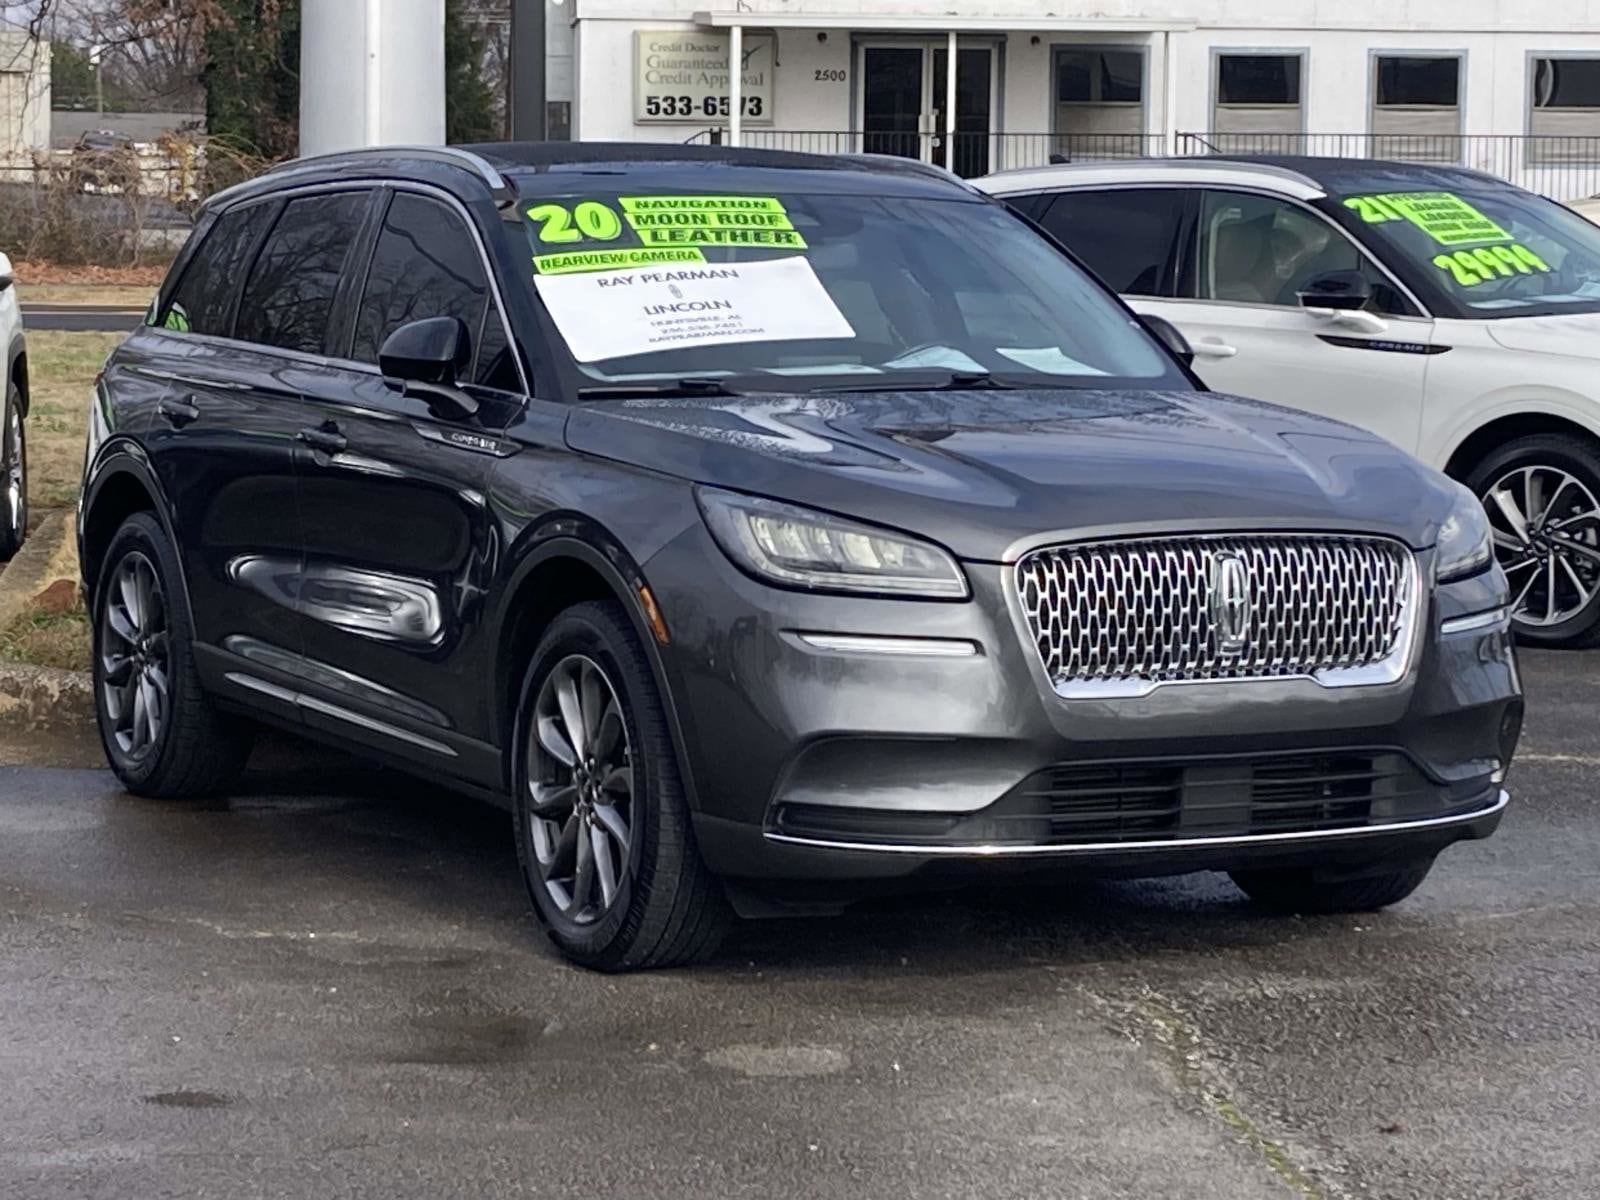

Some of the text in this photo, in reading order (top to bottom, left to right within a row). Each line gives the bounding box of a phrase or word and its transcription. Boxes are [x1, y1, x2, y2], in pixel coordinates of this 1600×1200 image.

[650, 42, 720, 52] Credit Doctor
[646, 55, 730, 70] Guaranteed
[645, 71, 764, 88] Credit Appval
[814, 69, 847, 82] 2500
[634, 199, 768, 210] NAVIGATION
[527, 202, 622, 243] 20
[634, 213, 780, 226] MOON ROOF
[651, 230, 797, 244] LEATHER
[540, 250, 699, 270] REARVIEW CAMERA
[597, 269, 740, 288] RAY PEARMAN
[644, 300, 733, 316] LINCOLN
